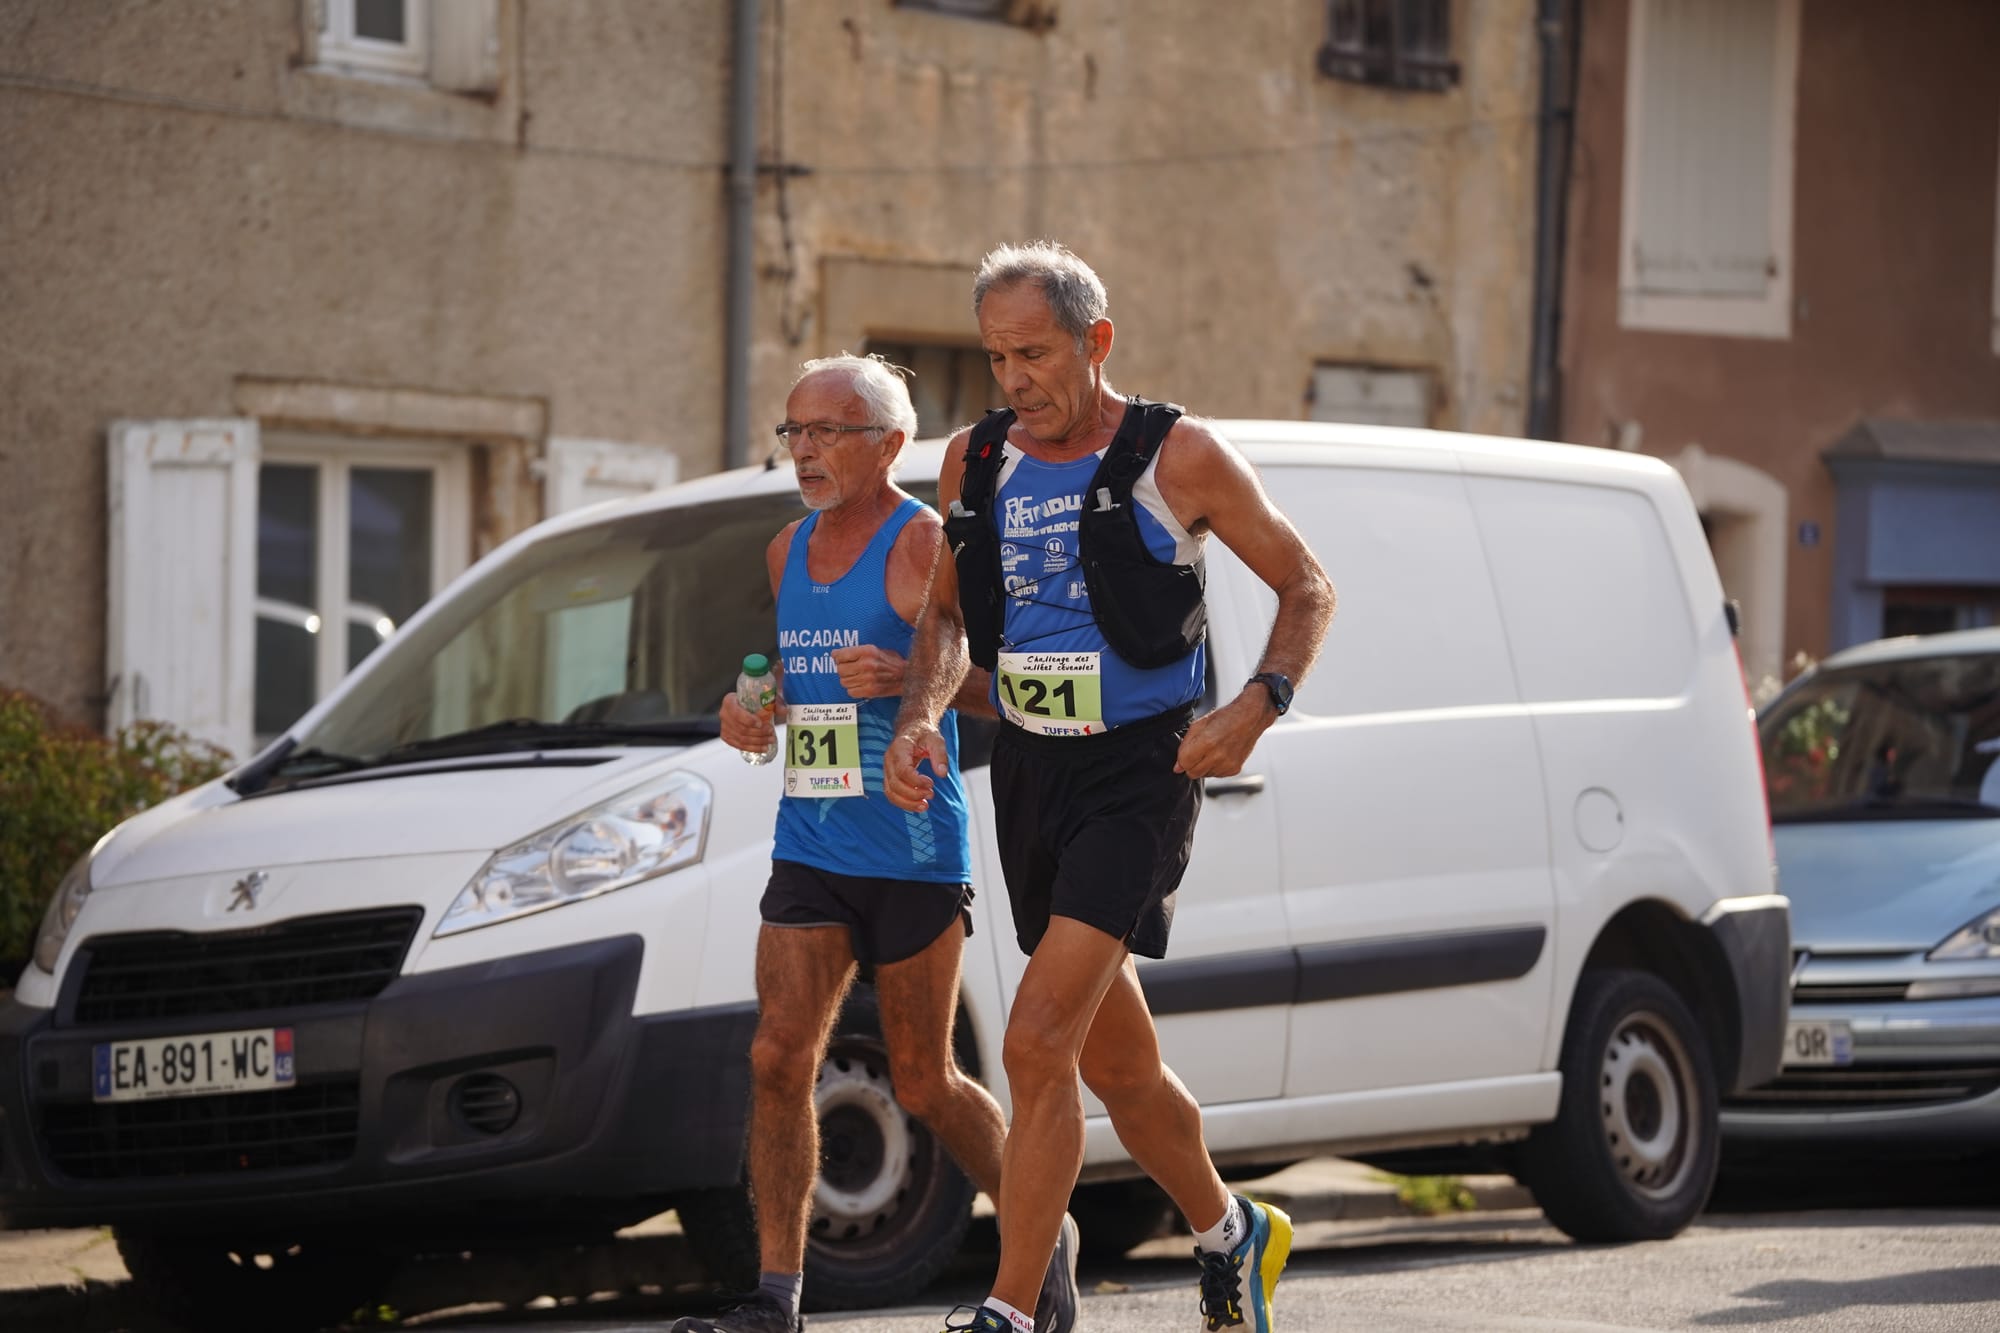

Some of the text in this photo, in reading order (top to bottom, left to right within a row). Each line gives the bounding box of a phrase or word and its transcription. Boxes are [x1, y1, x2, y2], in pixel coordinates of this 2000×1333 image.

[780, 629, 859, 648] MACADAM
[1027, 655, 1090, 664] Challenge des
[1001, 674, 1077, 717] 121
[803, 707, 832, 716] Challenge
[1042, 726, 1080, 735] TUFF'S
[789, 729, 837, 766] 131
[809, 777, 839, 785] TUFF'S
[115, 1037, 269, 1089] EA-891-WC
[276, 1055, 293, 1077] 48
